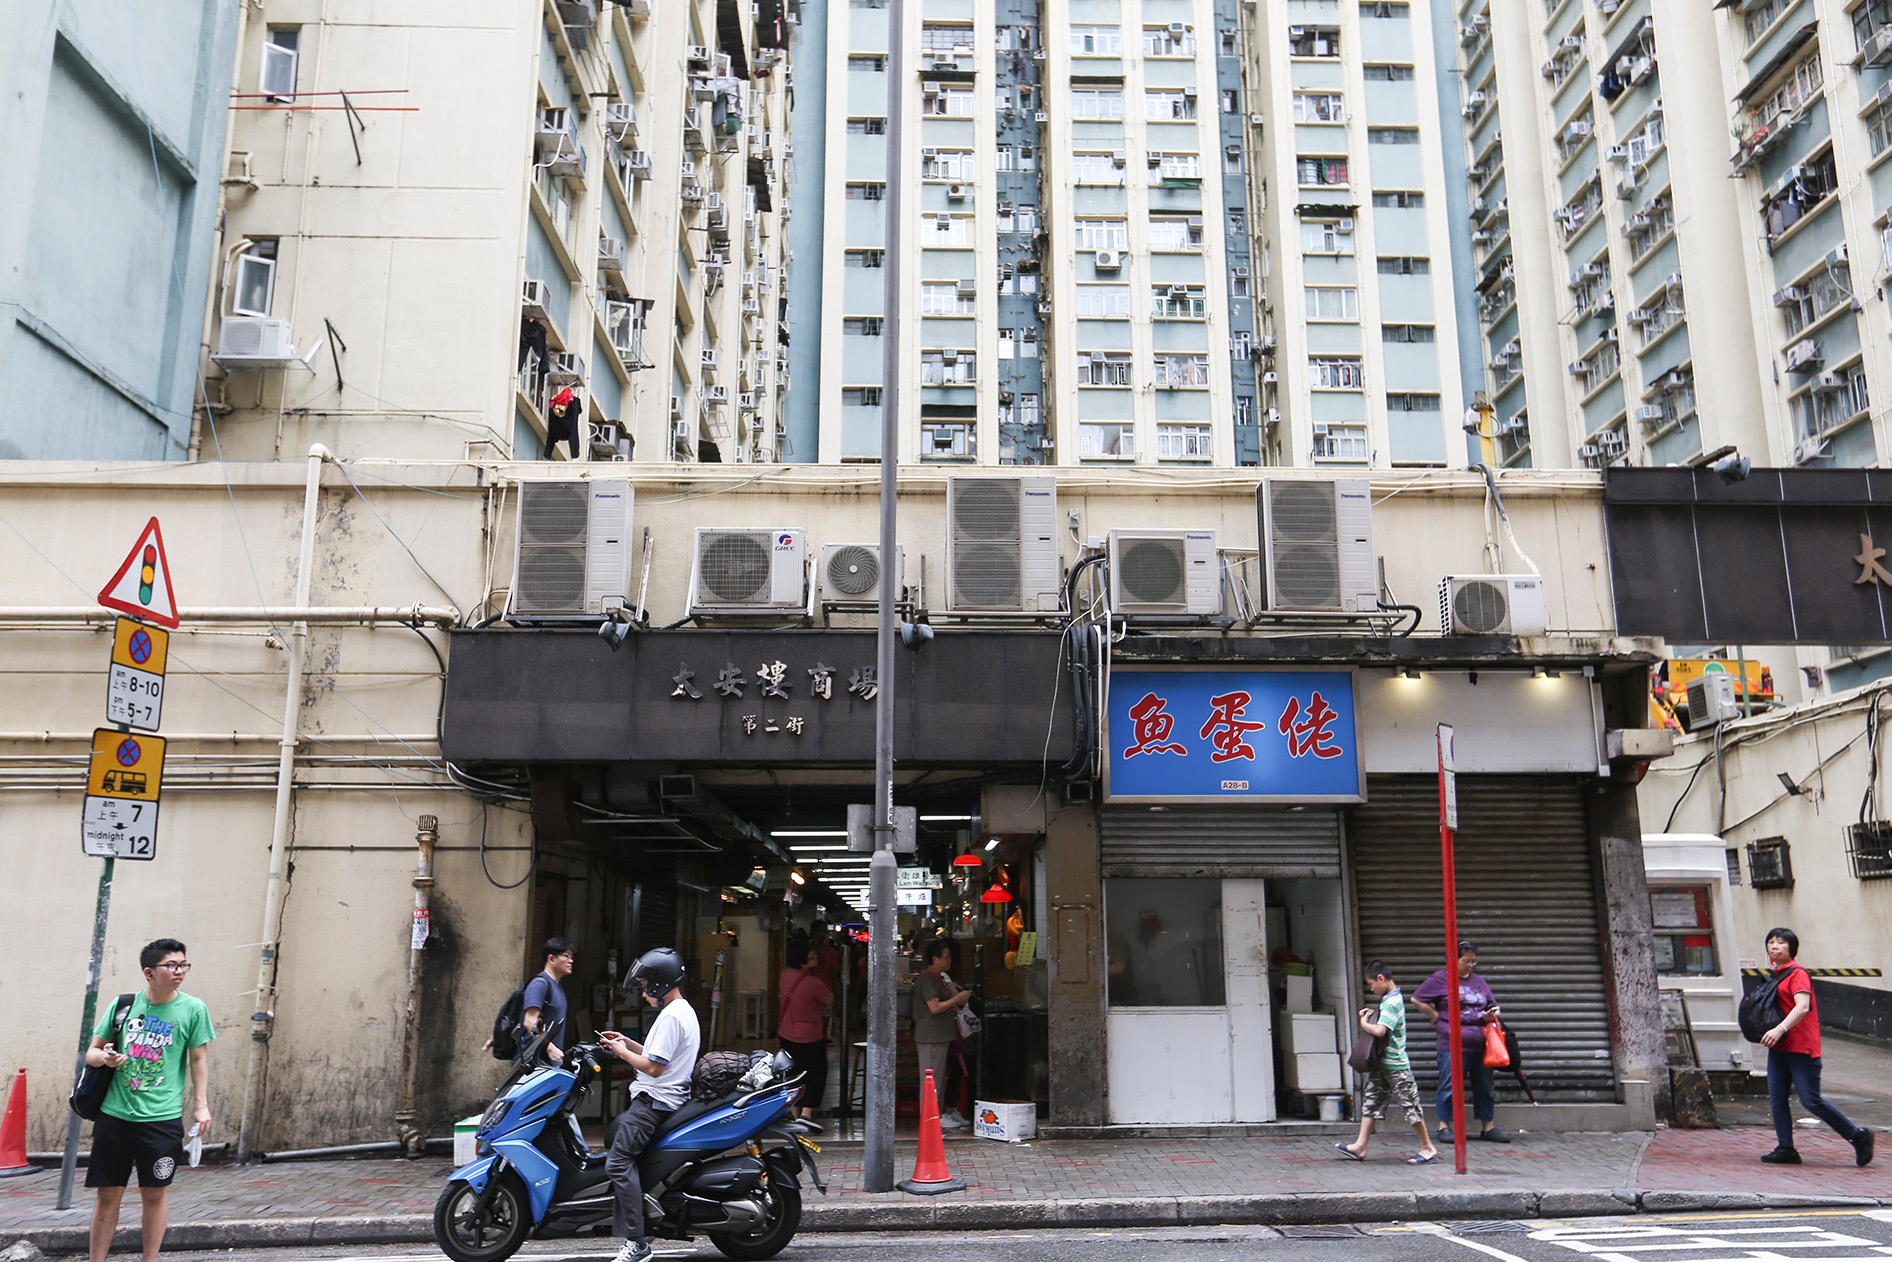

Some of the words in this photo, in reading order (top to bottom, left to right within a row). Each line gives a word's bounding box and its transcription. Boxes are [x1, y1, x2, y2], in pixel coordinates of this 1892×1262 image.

[116, 670, 126, 678] am
[129, 677, 159, 697] 8-10
[114, 696, 123, 704] pm
[742, 714, 805, 735] 第二街
[1123, 691, 1343, 763] 魚蛋佬
[97, 810, 118, 820] 上午
[102, 800, 115, 808] am
[131, 805, 143, 822] 7
[87, 831, 124, 841] midnight
[129, 836, 150, 855] 12
[144, 1015, 174, 1036] THE
[124, 1032, 173, 1049] PANDA
[976, 1121, 1005, 1136] Sunkist
